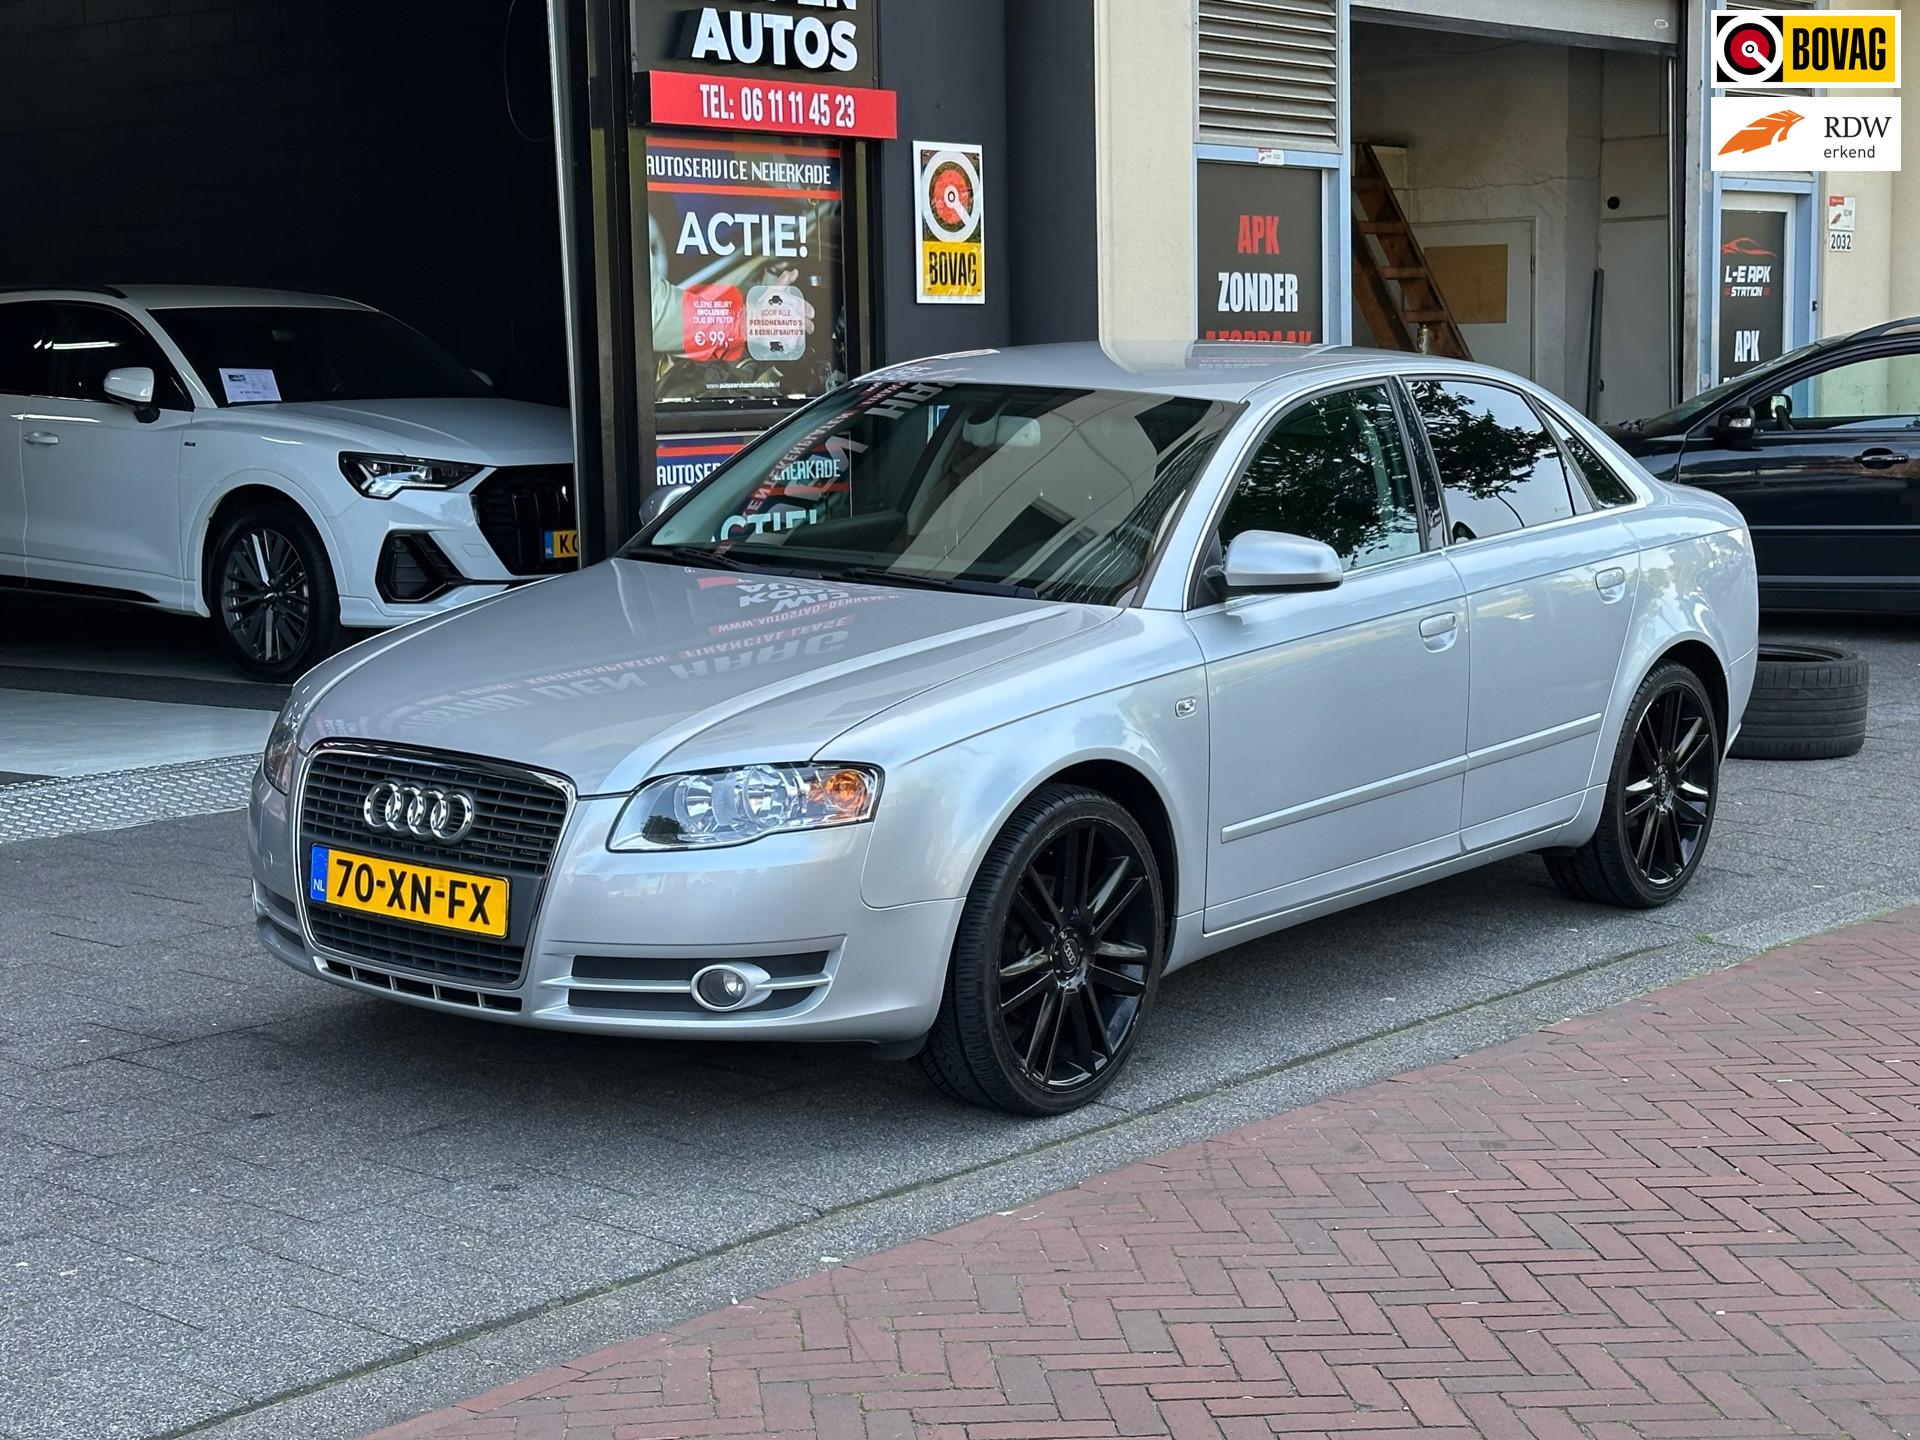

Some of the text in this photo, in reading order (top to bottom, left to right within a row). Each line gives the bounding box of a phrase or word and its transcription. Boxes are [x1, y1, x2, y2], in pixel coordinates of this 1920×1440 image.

[691, 7, 858, 72] AUTOS
[700, 84, 855, 128] TEL: 06 11 11 45 23
[646, 155, 831, 185] AUTOSERVICE NEHERKADE
[676, 211, 808, 258] ACTIE!
[1237, 215, 1280, 254] APK
[1831, 234, 1852, 250] 2032
[929, 251, 976, 286] BOVAG
[1747, 265, 1771, 283] APK
[1218, 272, 1298, 312] ZONDER
[1731, 286, 1763, 297] STATION
[694, 331, 734, 348] € 99,-
[1734, 330, 1760, 362] APK
[772, 459, 841, 481] HERKADE
[313, 878, 325, 892] NL
[336, 858, 491, 925] 70-XN-FX
